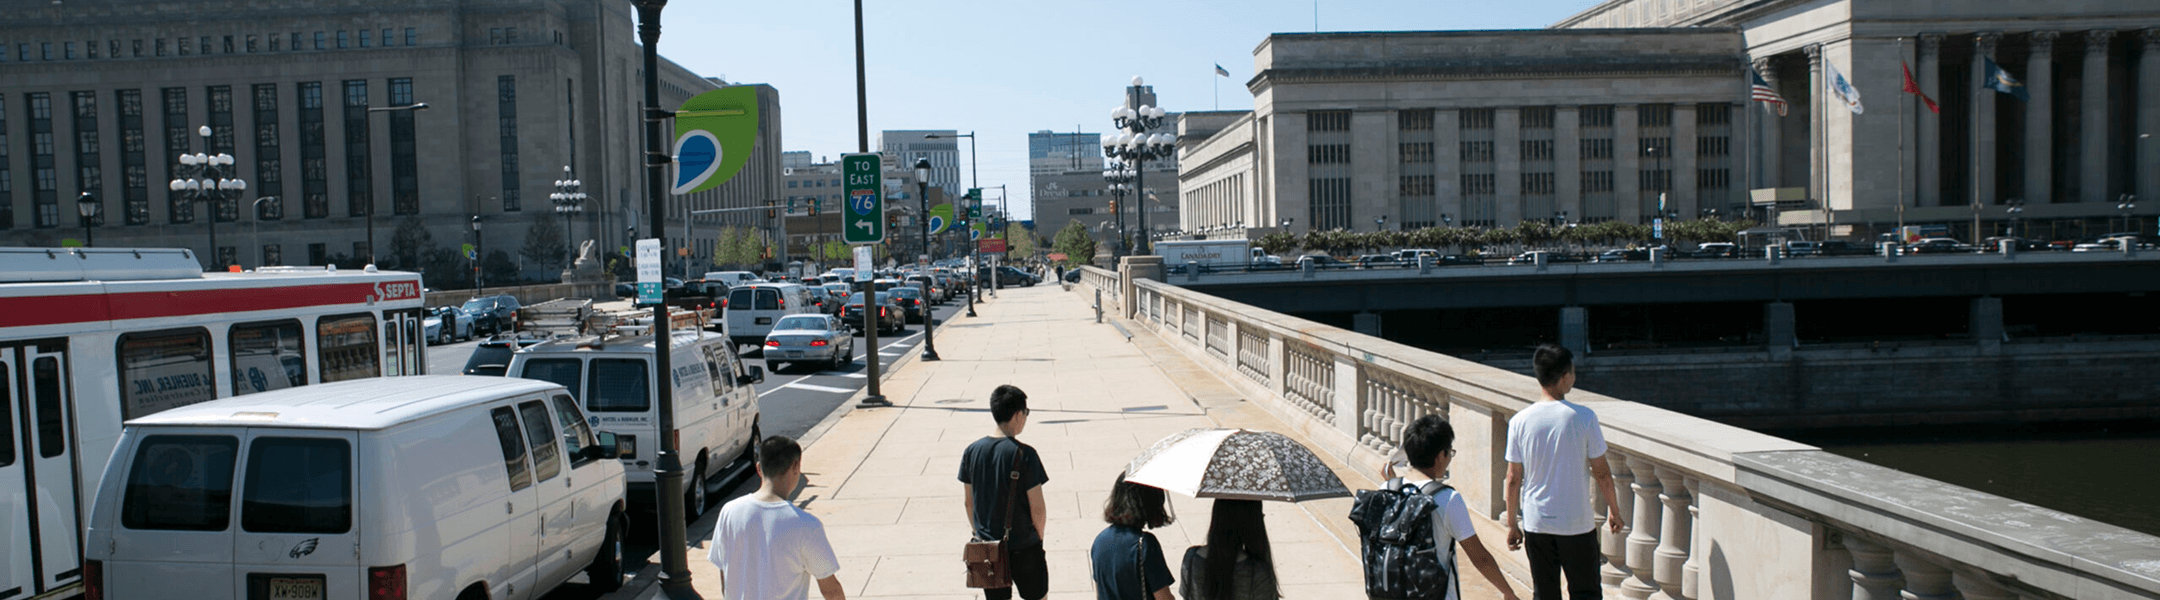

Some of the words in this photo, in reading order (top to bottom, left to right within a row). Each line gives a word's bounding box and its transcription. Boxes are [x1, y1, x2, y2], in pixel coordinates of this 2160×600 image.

[854, 161, 870, 171] TO
[850, 173, 874, 185] EAST
[852, 196, 873, 210] 76
[385, 283, 416, 298] SEPTA
